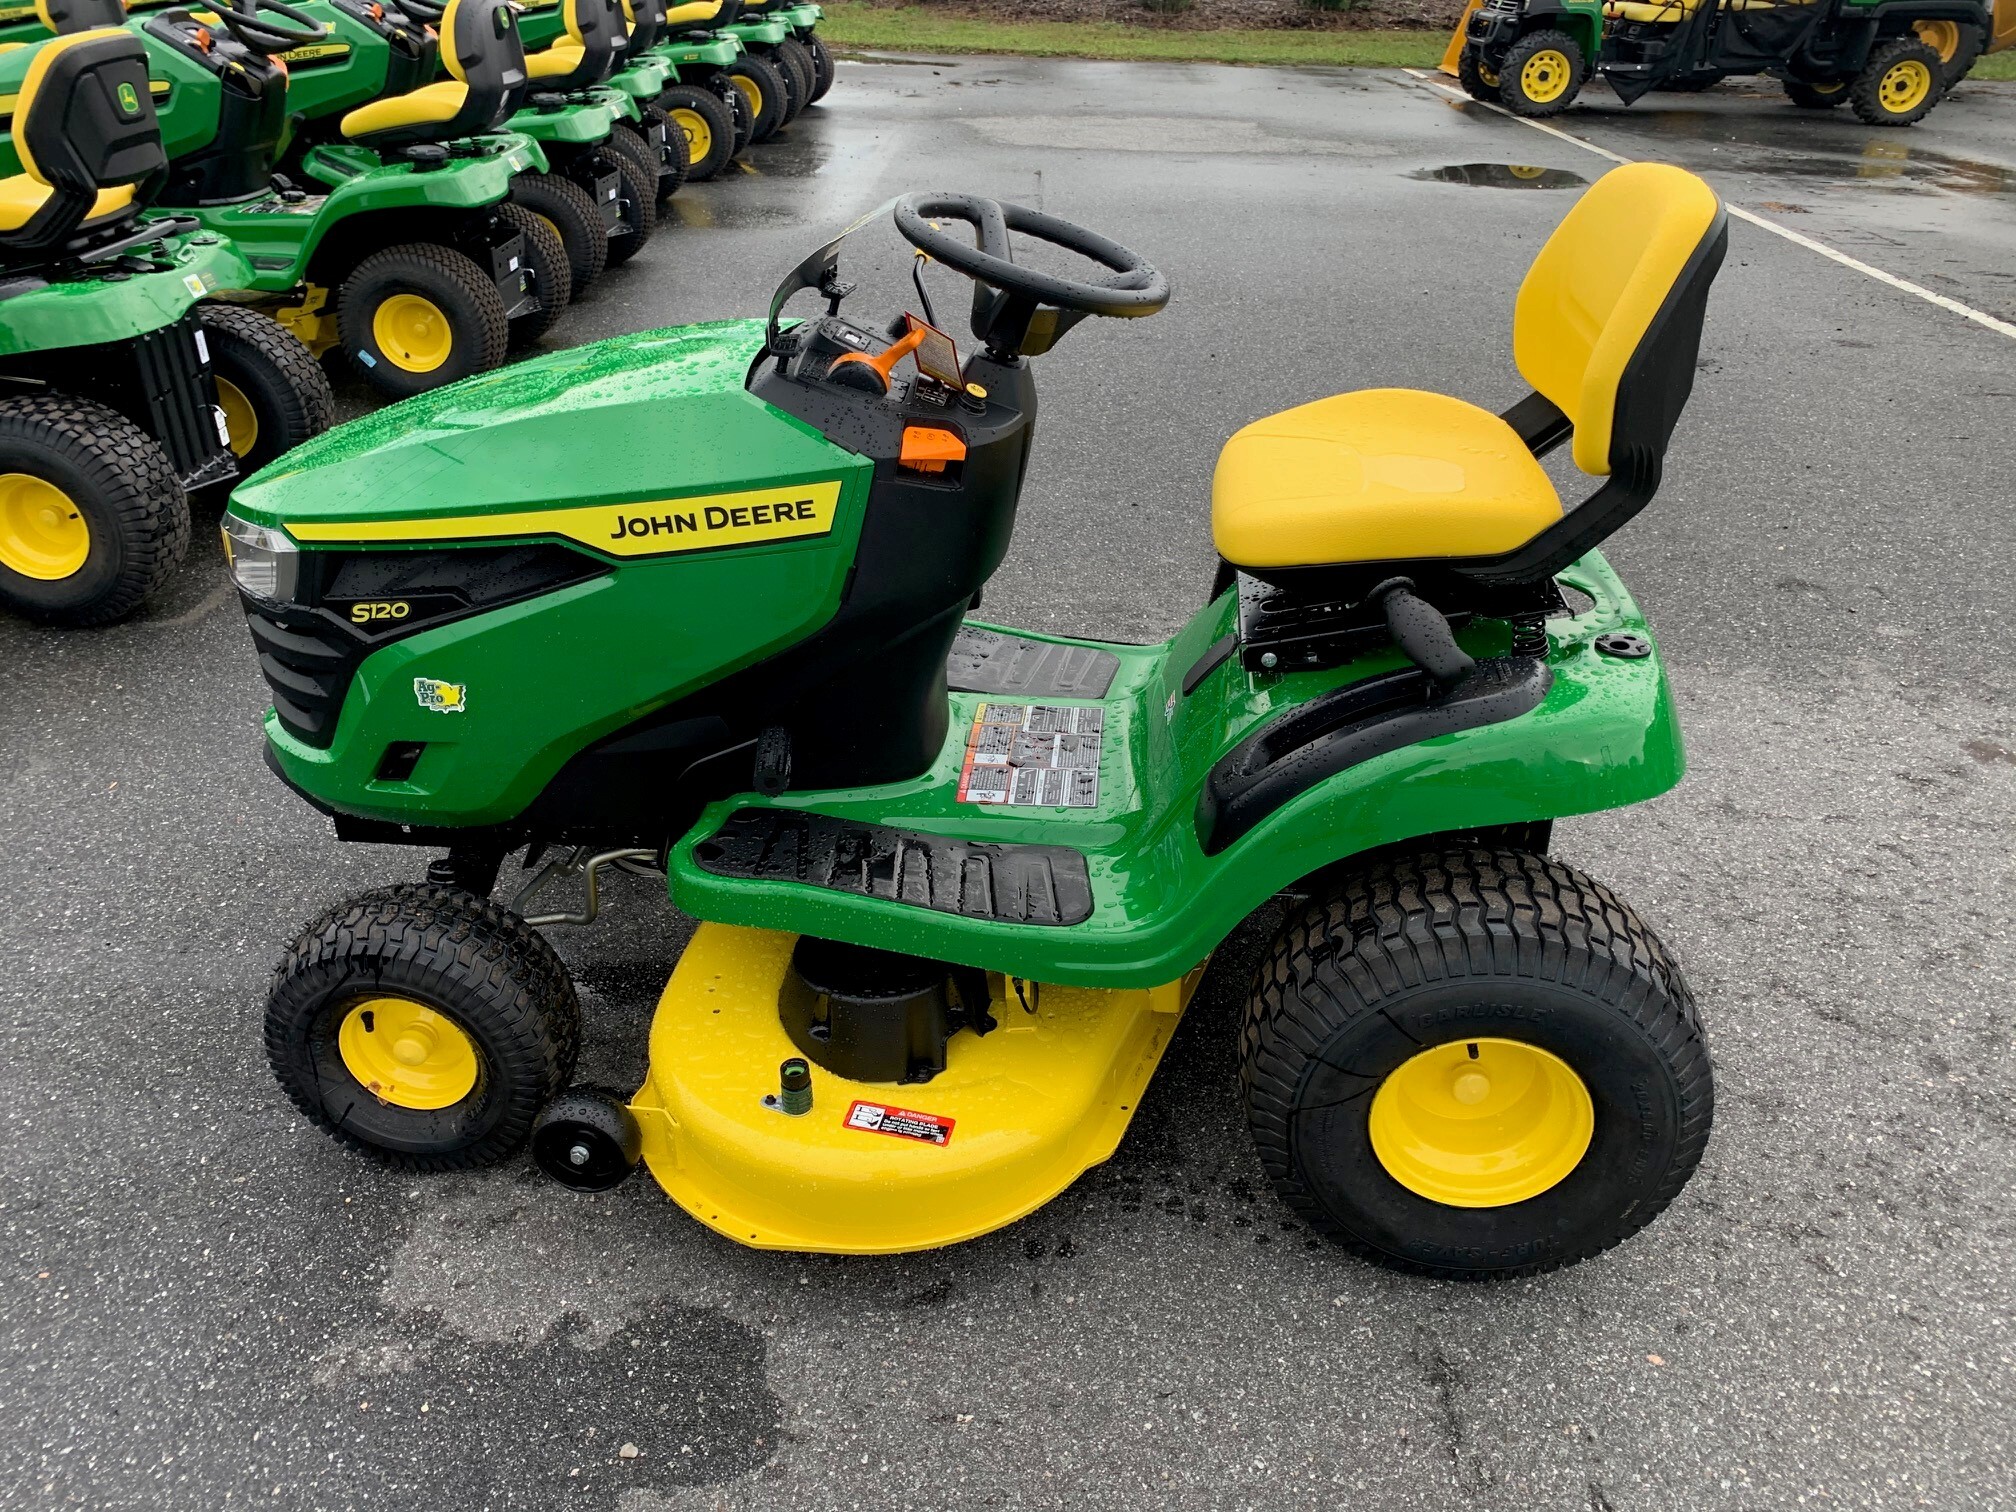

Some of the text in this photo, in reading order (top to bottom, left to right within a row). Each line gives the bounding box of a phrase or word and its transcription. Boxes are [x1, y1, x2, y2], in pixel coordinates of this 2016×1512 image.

[289, 49, 322, 59] DEERE
[610, 499, 816, 539] JOHN DEERE
[351, 602, 410, 623] S120
[417, 681, 440, 694] Ag-
[420, 692, 444, 703] Pro
[1418, 1003, 1547, 1028] CARLISLE
[889, 1116, 939, 1130] ROTATING BLADE
[907, 1112, 937, 1122] DANGER
